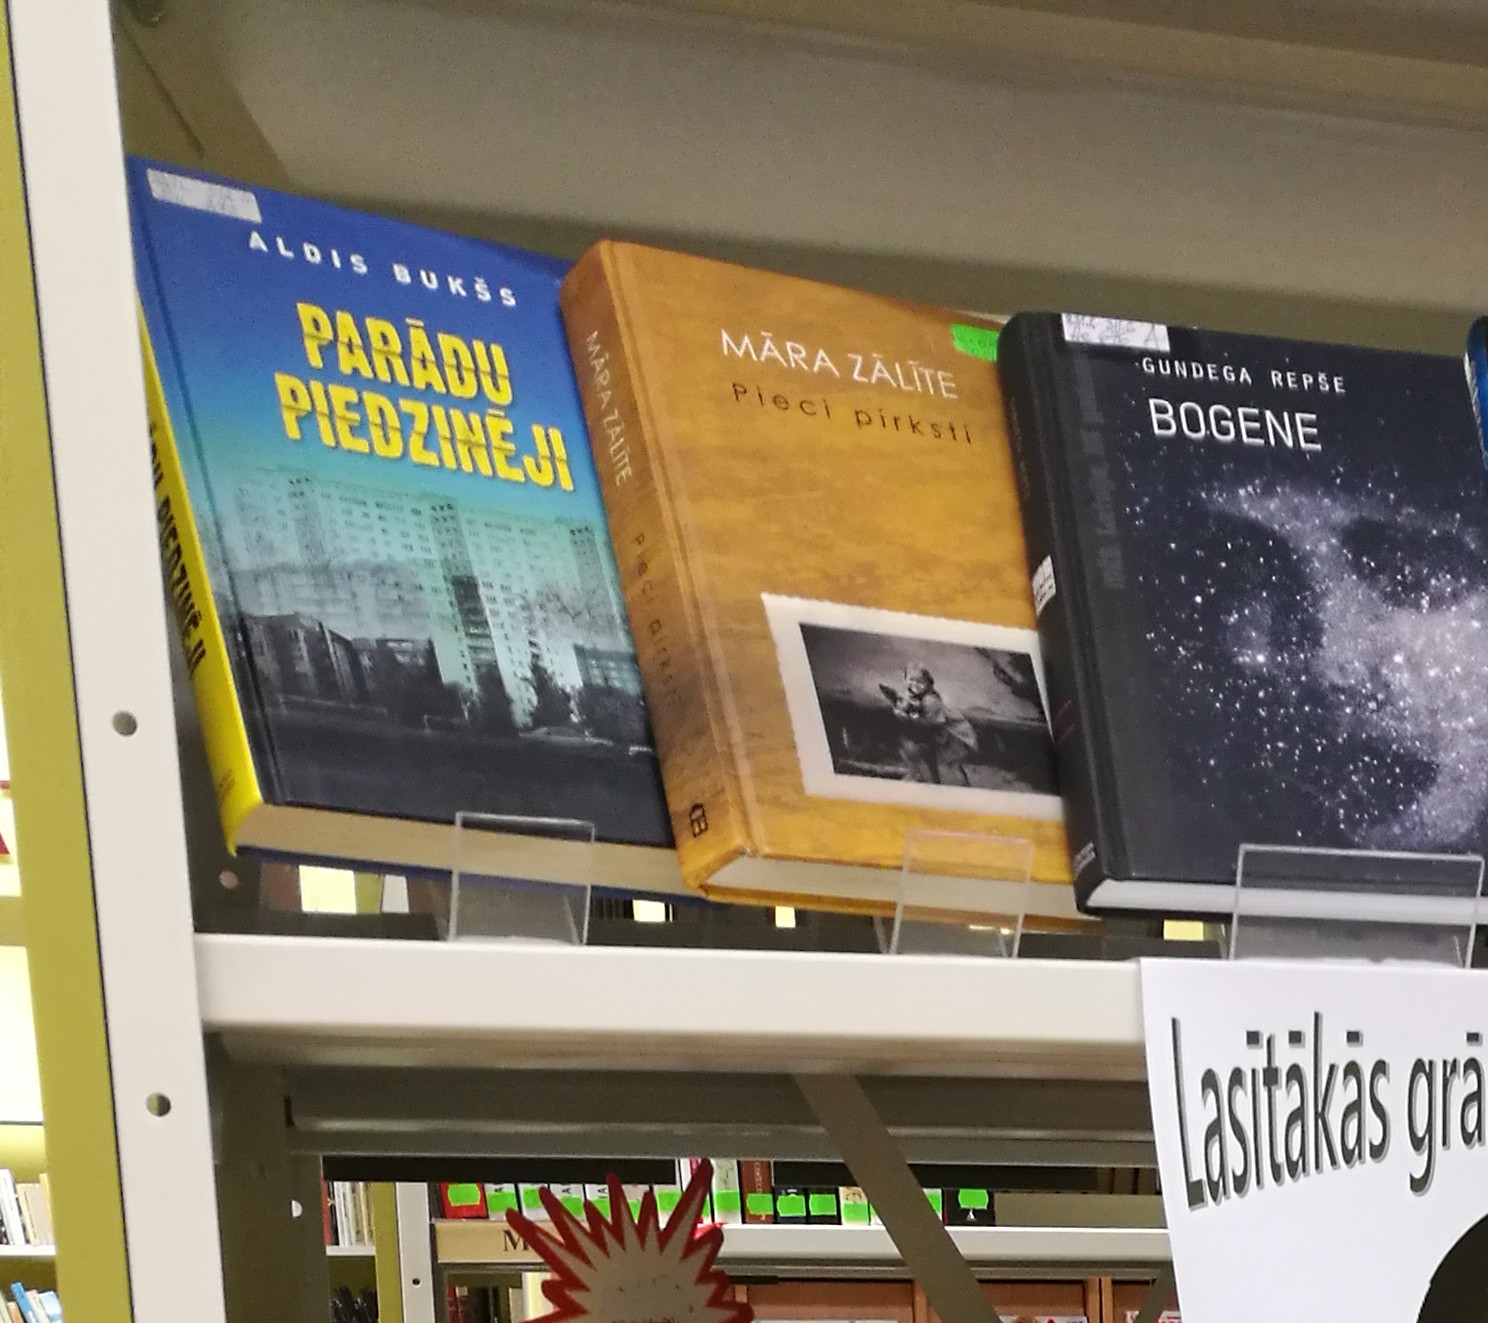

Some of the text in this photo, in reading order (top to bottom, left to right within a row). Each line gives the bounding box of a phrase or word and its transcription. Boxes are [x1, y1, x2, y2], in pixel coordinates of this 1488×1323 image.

[248, 229, 517, 308] ALDIS BUKŠS
[296, 301, 514, 407] PARĀDU
[721, 329, 959, 400] MĀRA ZĀLĪTE
[1141, 356, 1347, 395] GUNDEGA REPŠE
[275, 372, 577, 494] PIEDZINĒJI
[586, 329, 634, 487] MĀRA ZĀLĪTE
[732, 381, 972, 445] Pieci pirksti
[1148, 396, 1324, 453] BOGENE
[1169, 1011, 1391, 1213] Lasītākās
